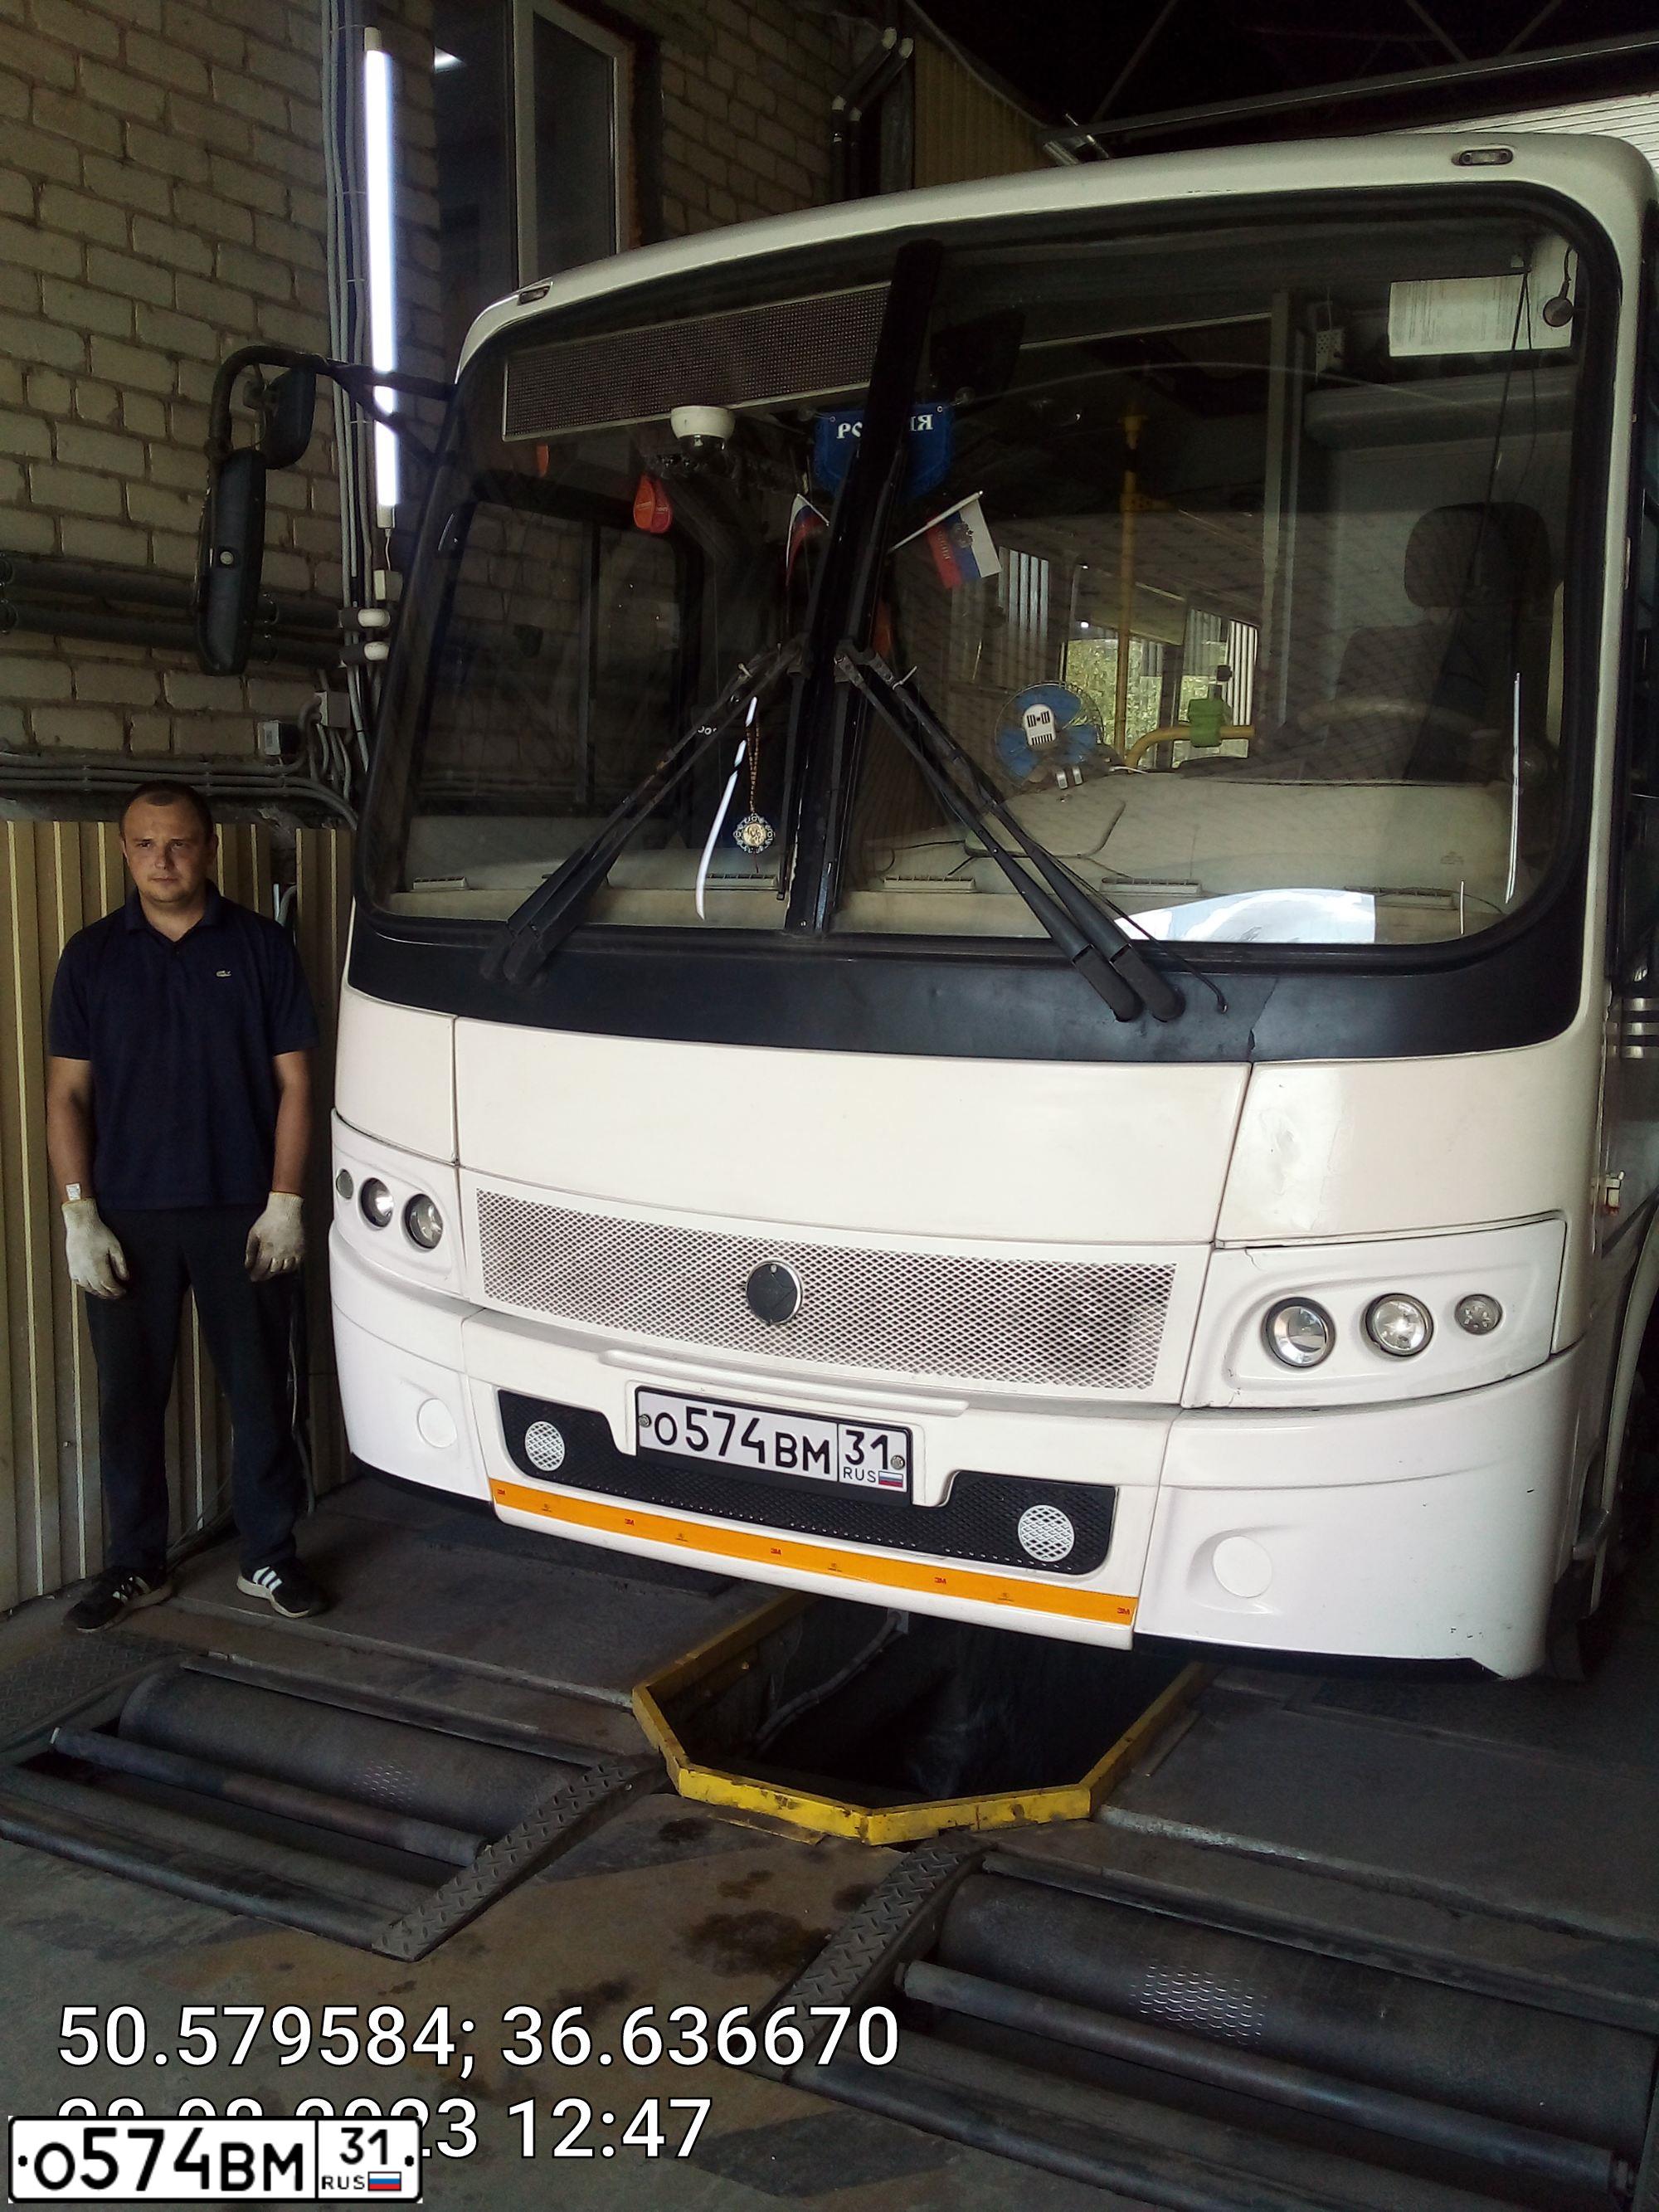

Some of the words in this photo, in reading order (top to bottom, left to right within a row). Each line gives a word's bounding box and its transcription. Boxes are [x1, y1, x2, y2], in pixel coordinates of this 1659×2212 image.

[654, 1406, 830, 1474] О574ВМ
[845, 1430, 888, 1469] 31
[843, 1467, 876, 1484] RUS
